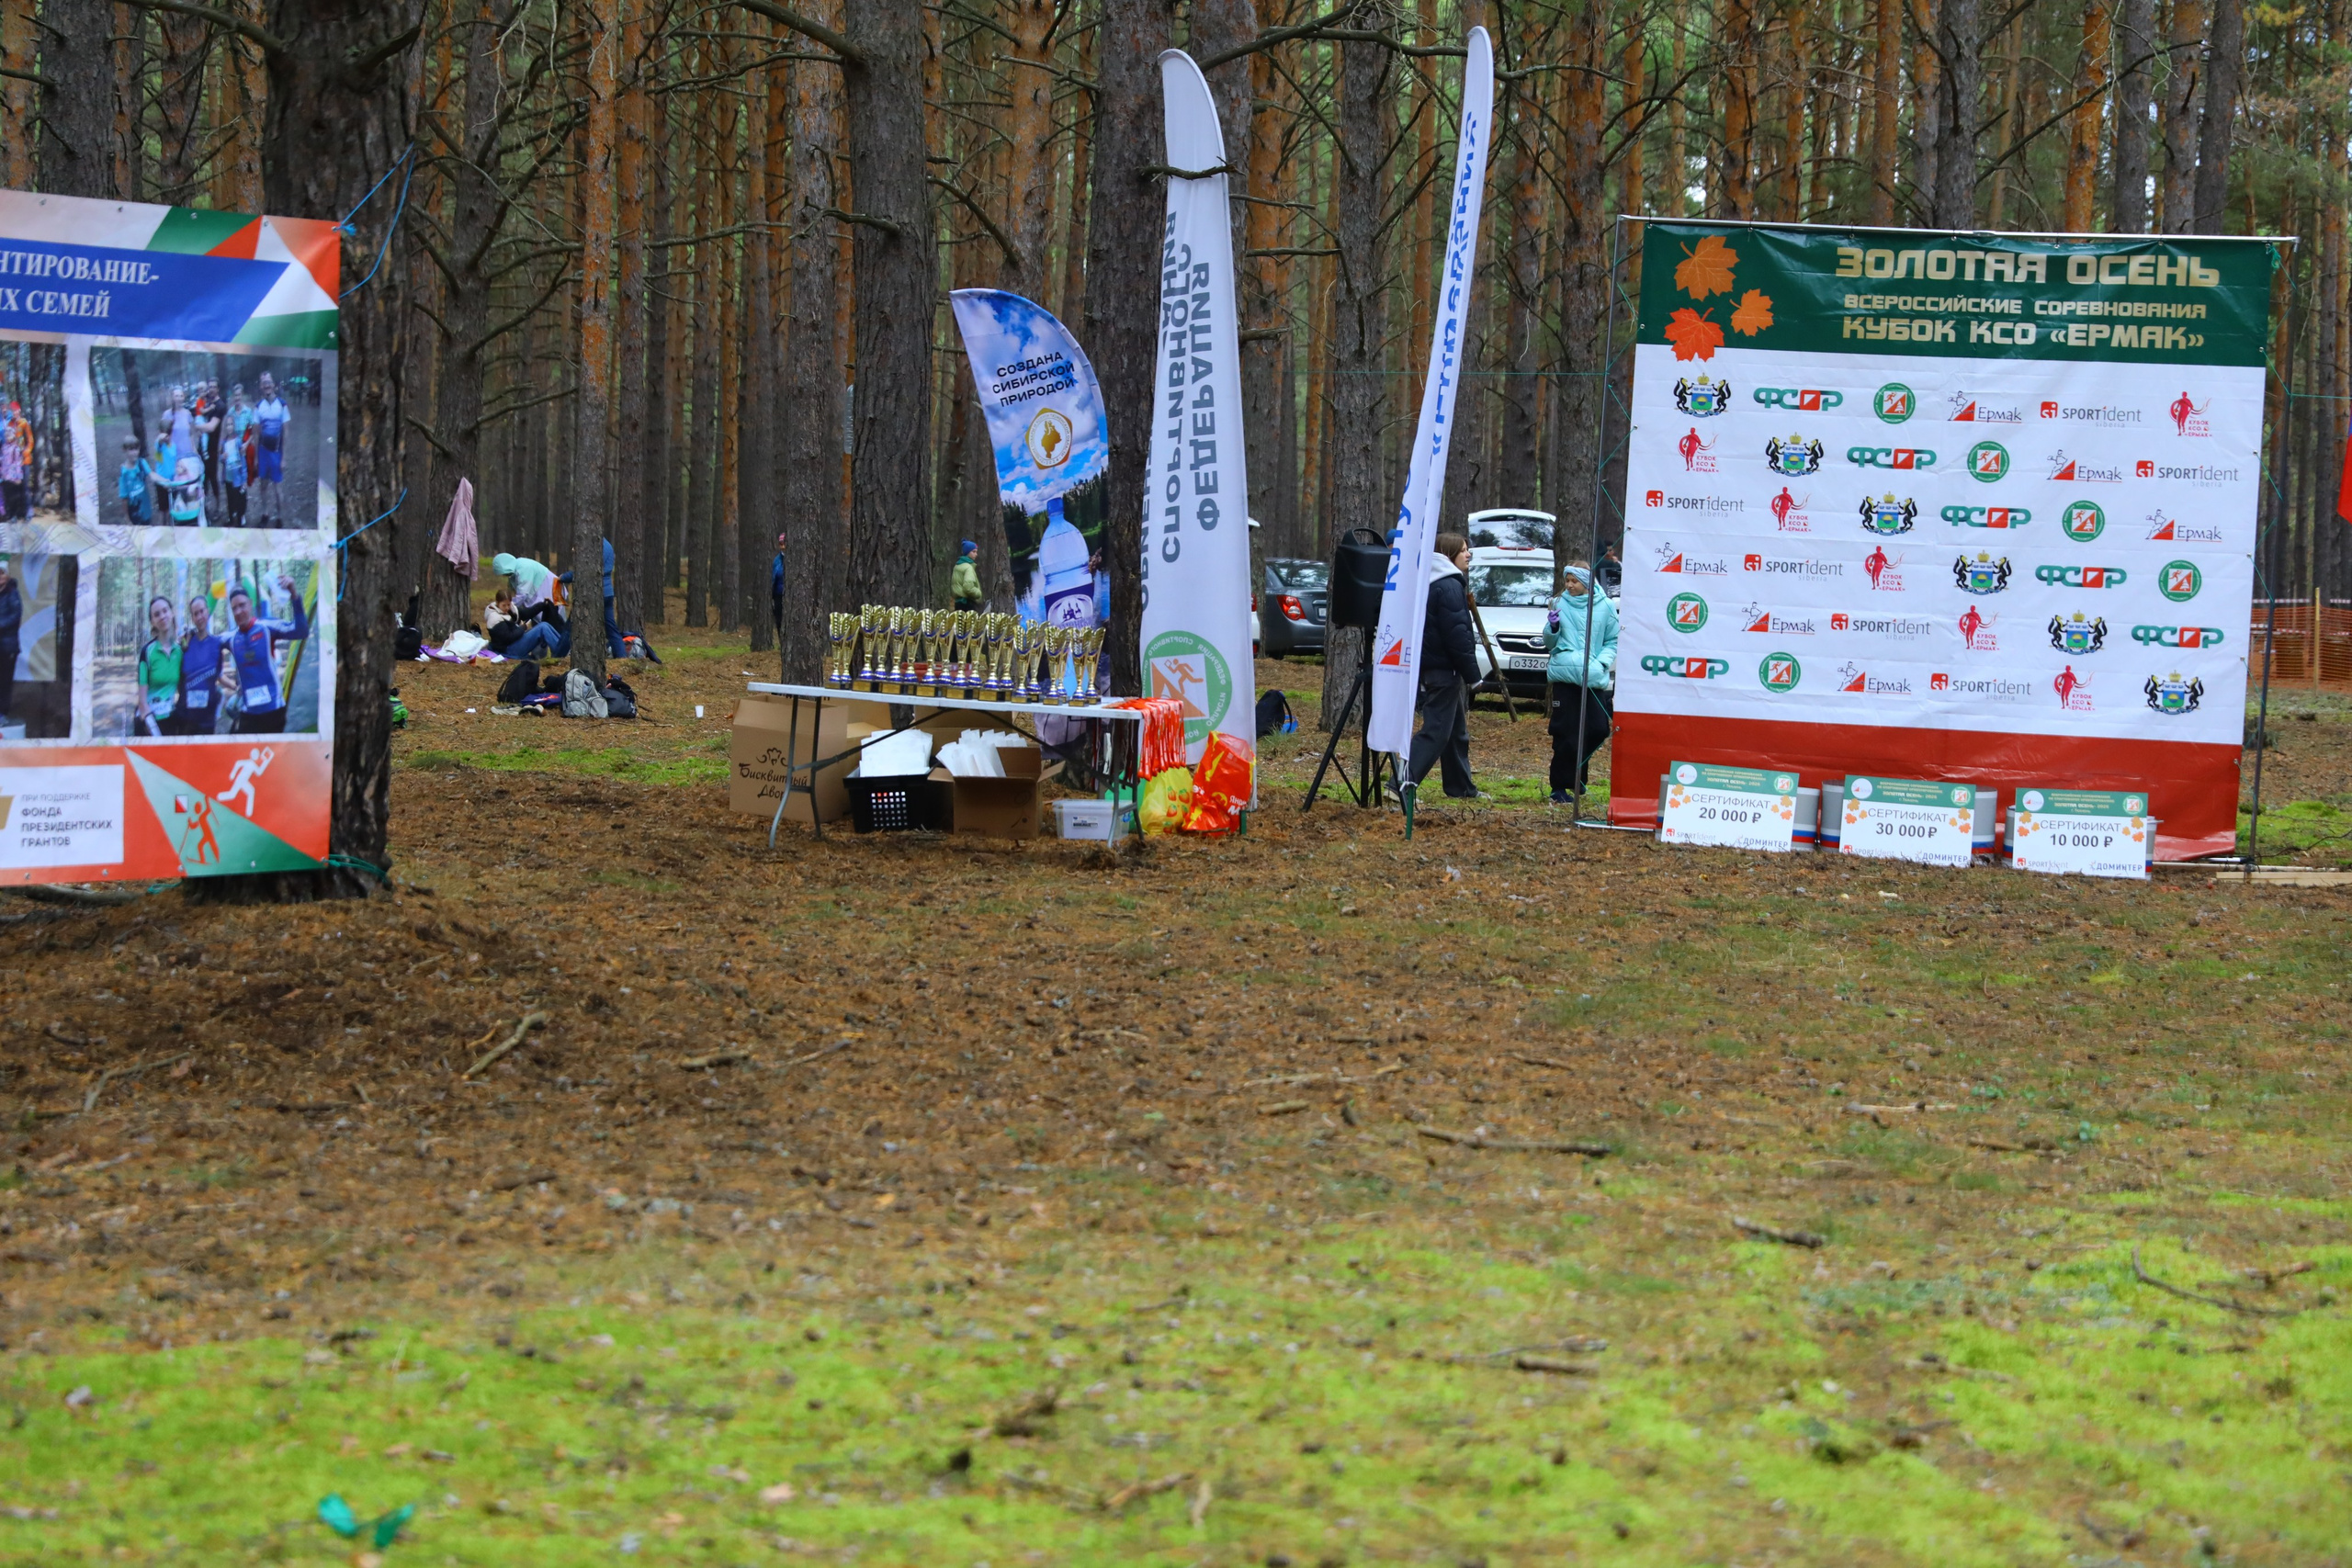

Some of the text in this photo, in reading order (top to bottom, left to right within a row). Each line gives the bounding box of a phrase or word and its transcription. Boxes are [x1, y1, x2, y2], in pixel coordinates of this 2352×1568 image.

[1836, 247, 2220, 288] ЗОЛОТАЯ ОСЕНЬ
[25, 289, 111, 318] СЕМЕЙ
[1844, 294, 2206, 319] ВСЕРОССИЙСКИЕ СОРЕВНОВАНИЯ
[1843, 316, 2204, 349] КУБОК КСО «ЕРМАК»
[997, 352, 1063, 377] СОЗДАНА
[992, 361, 1075, 394] СИБИРСКОЙ
[1000, 377, 1074, 407] ПРИРОДОЙ
[1978, 407, 2021, 422] Ермак
[2078, 467, 2122, 480] Ермак
[2177, 526, 2222, 540] Ермак
[1685, 559, 1727, 573] Ермак
[1772, 618, 1815, 633] Ермак
[1869, 678, 1911, 693] Ермак
[739, 762, 808, 786] Бисквитый
[21, 793, 90, 802] ПРИ ПОДДЕРЖКЕ
[1691, 794, 1770, 808] СЕРТИФИКАТ
[21, 807, 62, 818] ФОНДА
[1699, 807, 1716, 819] 20
[1722, 809, 1747, 822] 000
[1868, 807, 1948, 822] СЕРТИФИКАТ
[21, 819, 112, 832] ПРЕЗИДЕНТСКИХ
[1876, 823, 1894, 835] 30
[1899, 824, 1925, 838] 000
[2040, 819, 2121, 831] СЕРТИФИКАТ
[21, 836, 71, 848] ГРАНТОВ
[1743, 838, 1788, 847] ДОМИНТЕР
[2051, 834, 2066, 846] 10
[2073, 835, 2098, 847] 000
[1922, 852, 1968, 863] ДОМИНТЕР
[2096, 863, 2143, 872] ДОМИНТЕР
